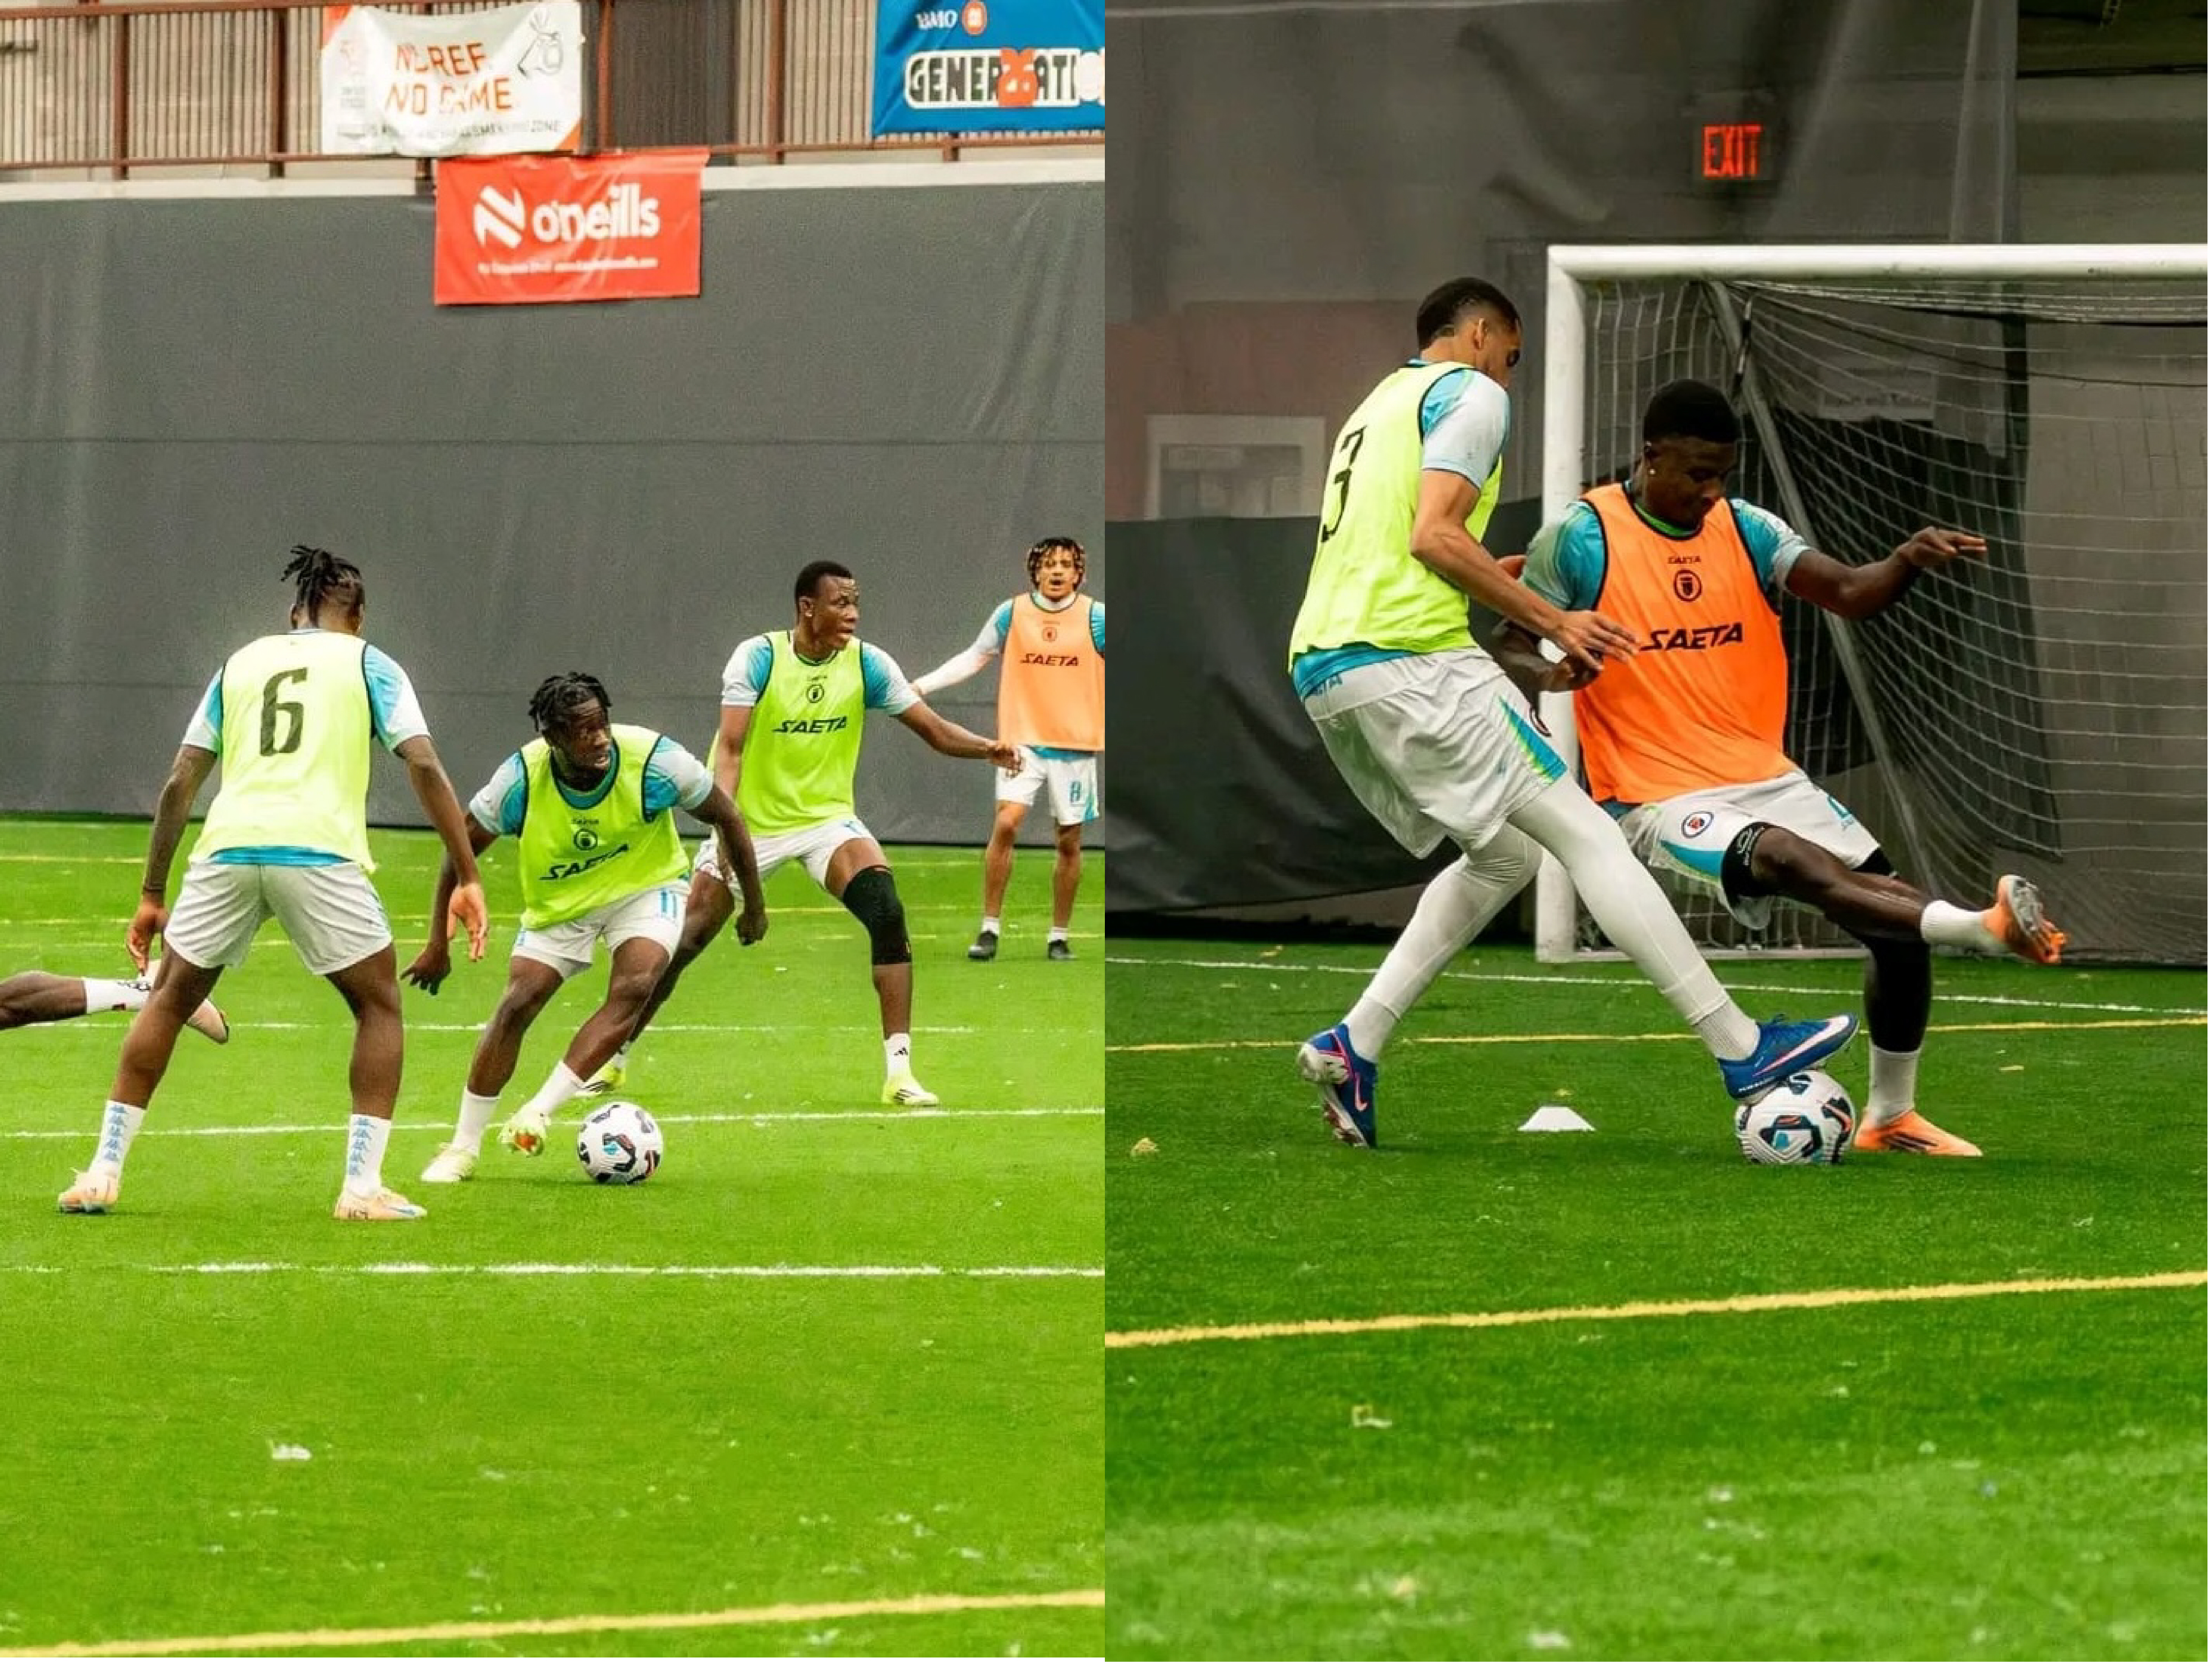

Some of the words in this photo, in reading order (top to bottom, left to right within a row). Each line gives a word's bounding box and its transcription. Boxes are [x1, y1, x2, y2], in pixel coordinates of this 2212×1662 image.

[428, 42, 486, 76] REF
[385, 82, 427, 115] NO
[1703, 125, 1761, 179] EXIT
[1321, 425, 1368, 543] 3
[1639, 622, 1743, 651] SAETA
[1020, 653, 1079, 666] SAETA
[260, 667, 308, 756] 6
[772, 716, 848, 733] SAETA
